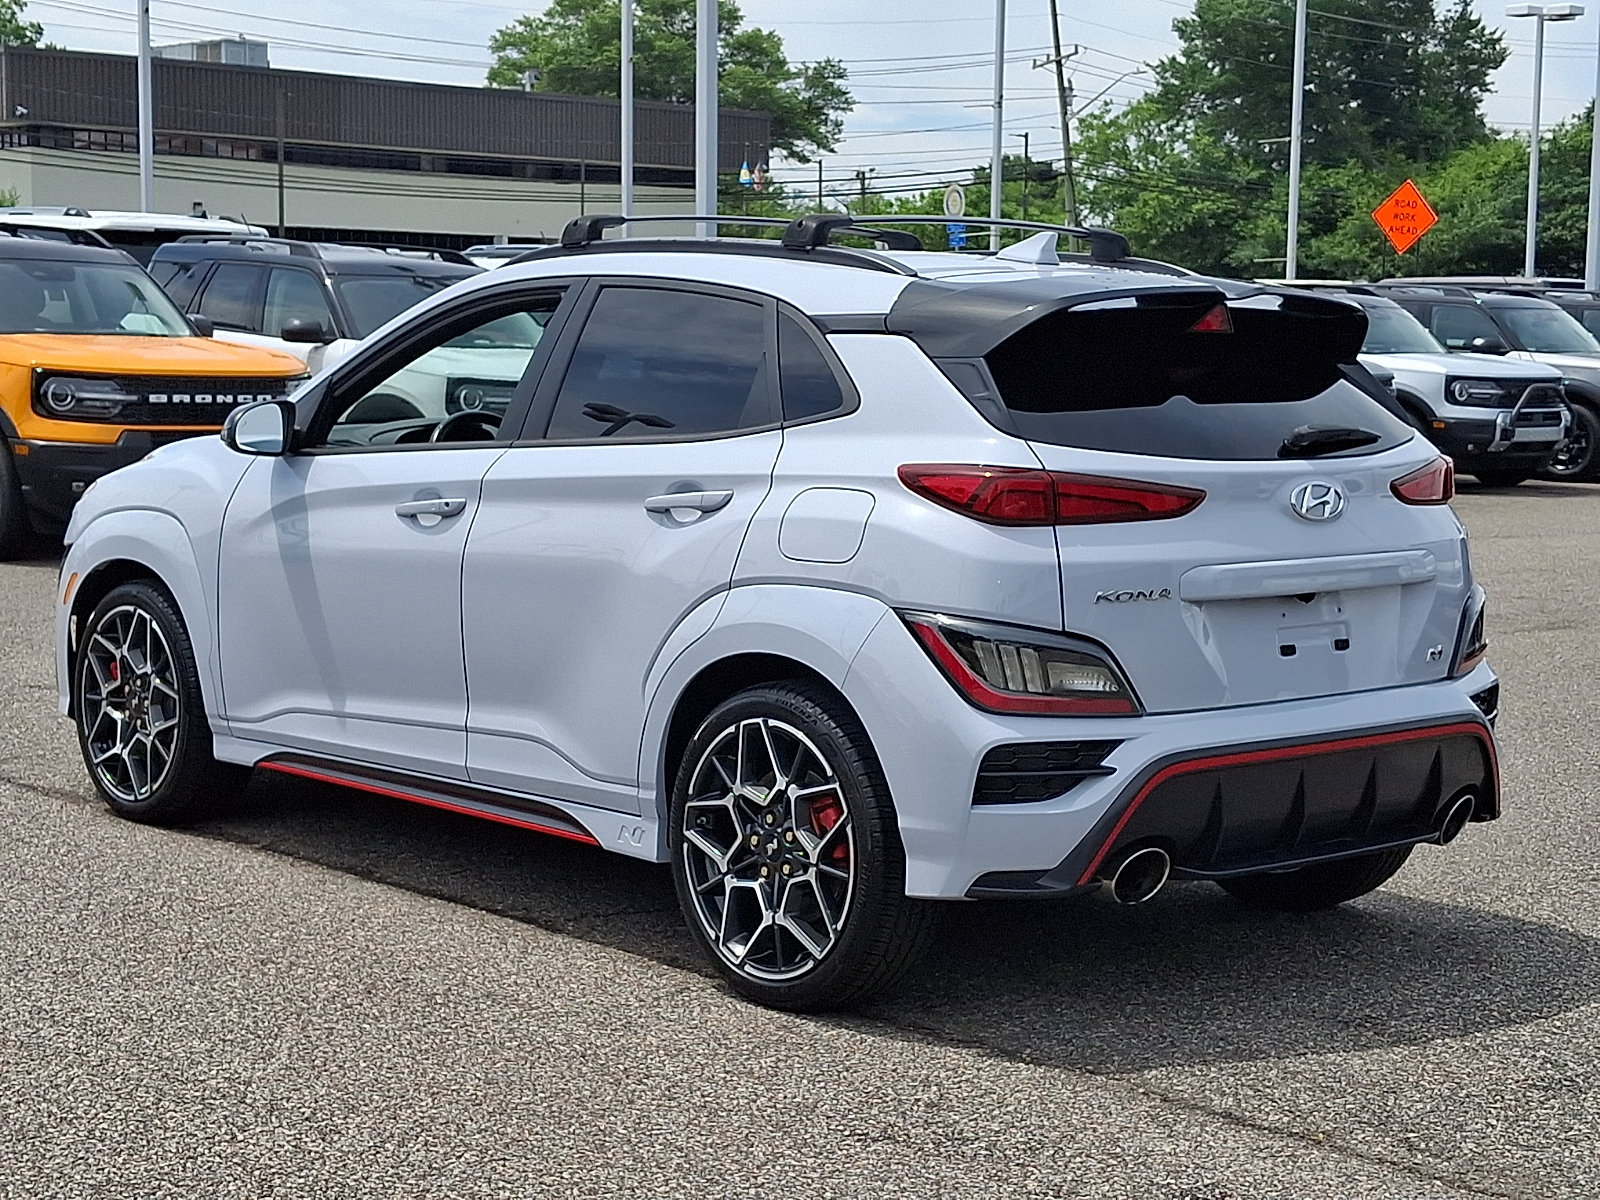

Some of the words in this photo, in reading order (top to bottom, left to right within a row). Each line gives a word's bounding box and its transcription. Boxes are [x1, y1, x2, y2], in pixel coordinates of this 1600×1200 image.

[1393, 199, 1418, 209] ROAD
[1393, 212, 1416, 222] WORK
[1388, 225, 1418, 235] AHEAD
[149, 394, 272, 404] BRONCO
[1093, 588, 1171, 604] KONA
